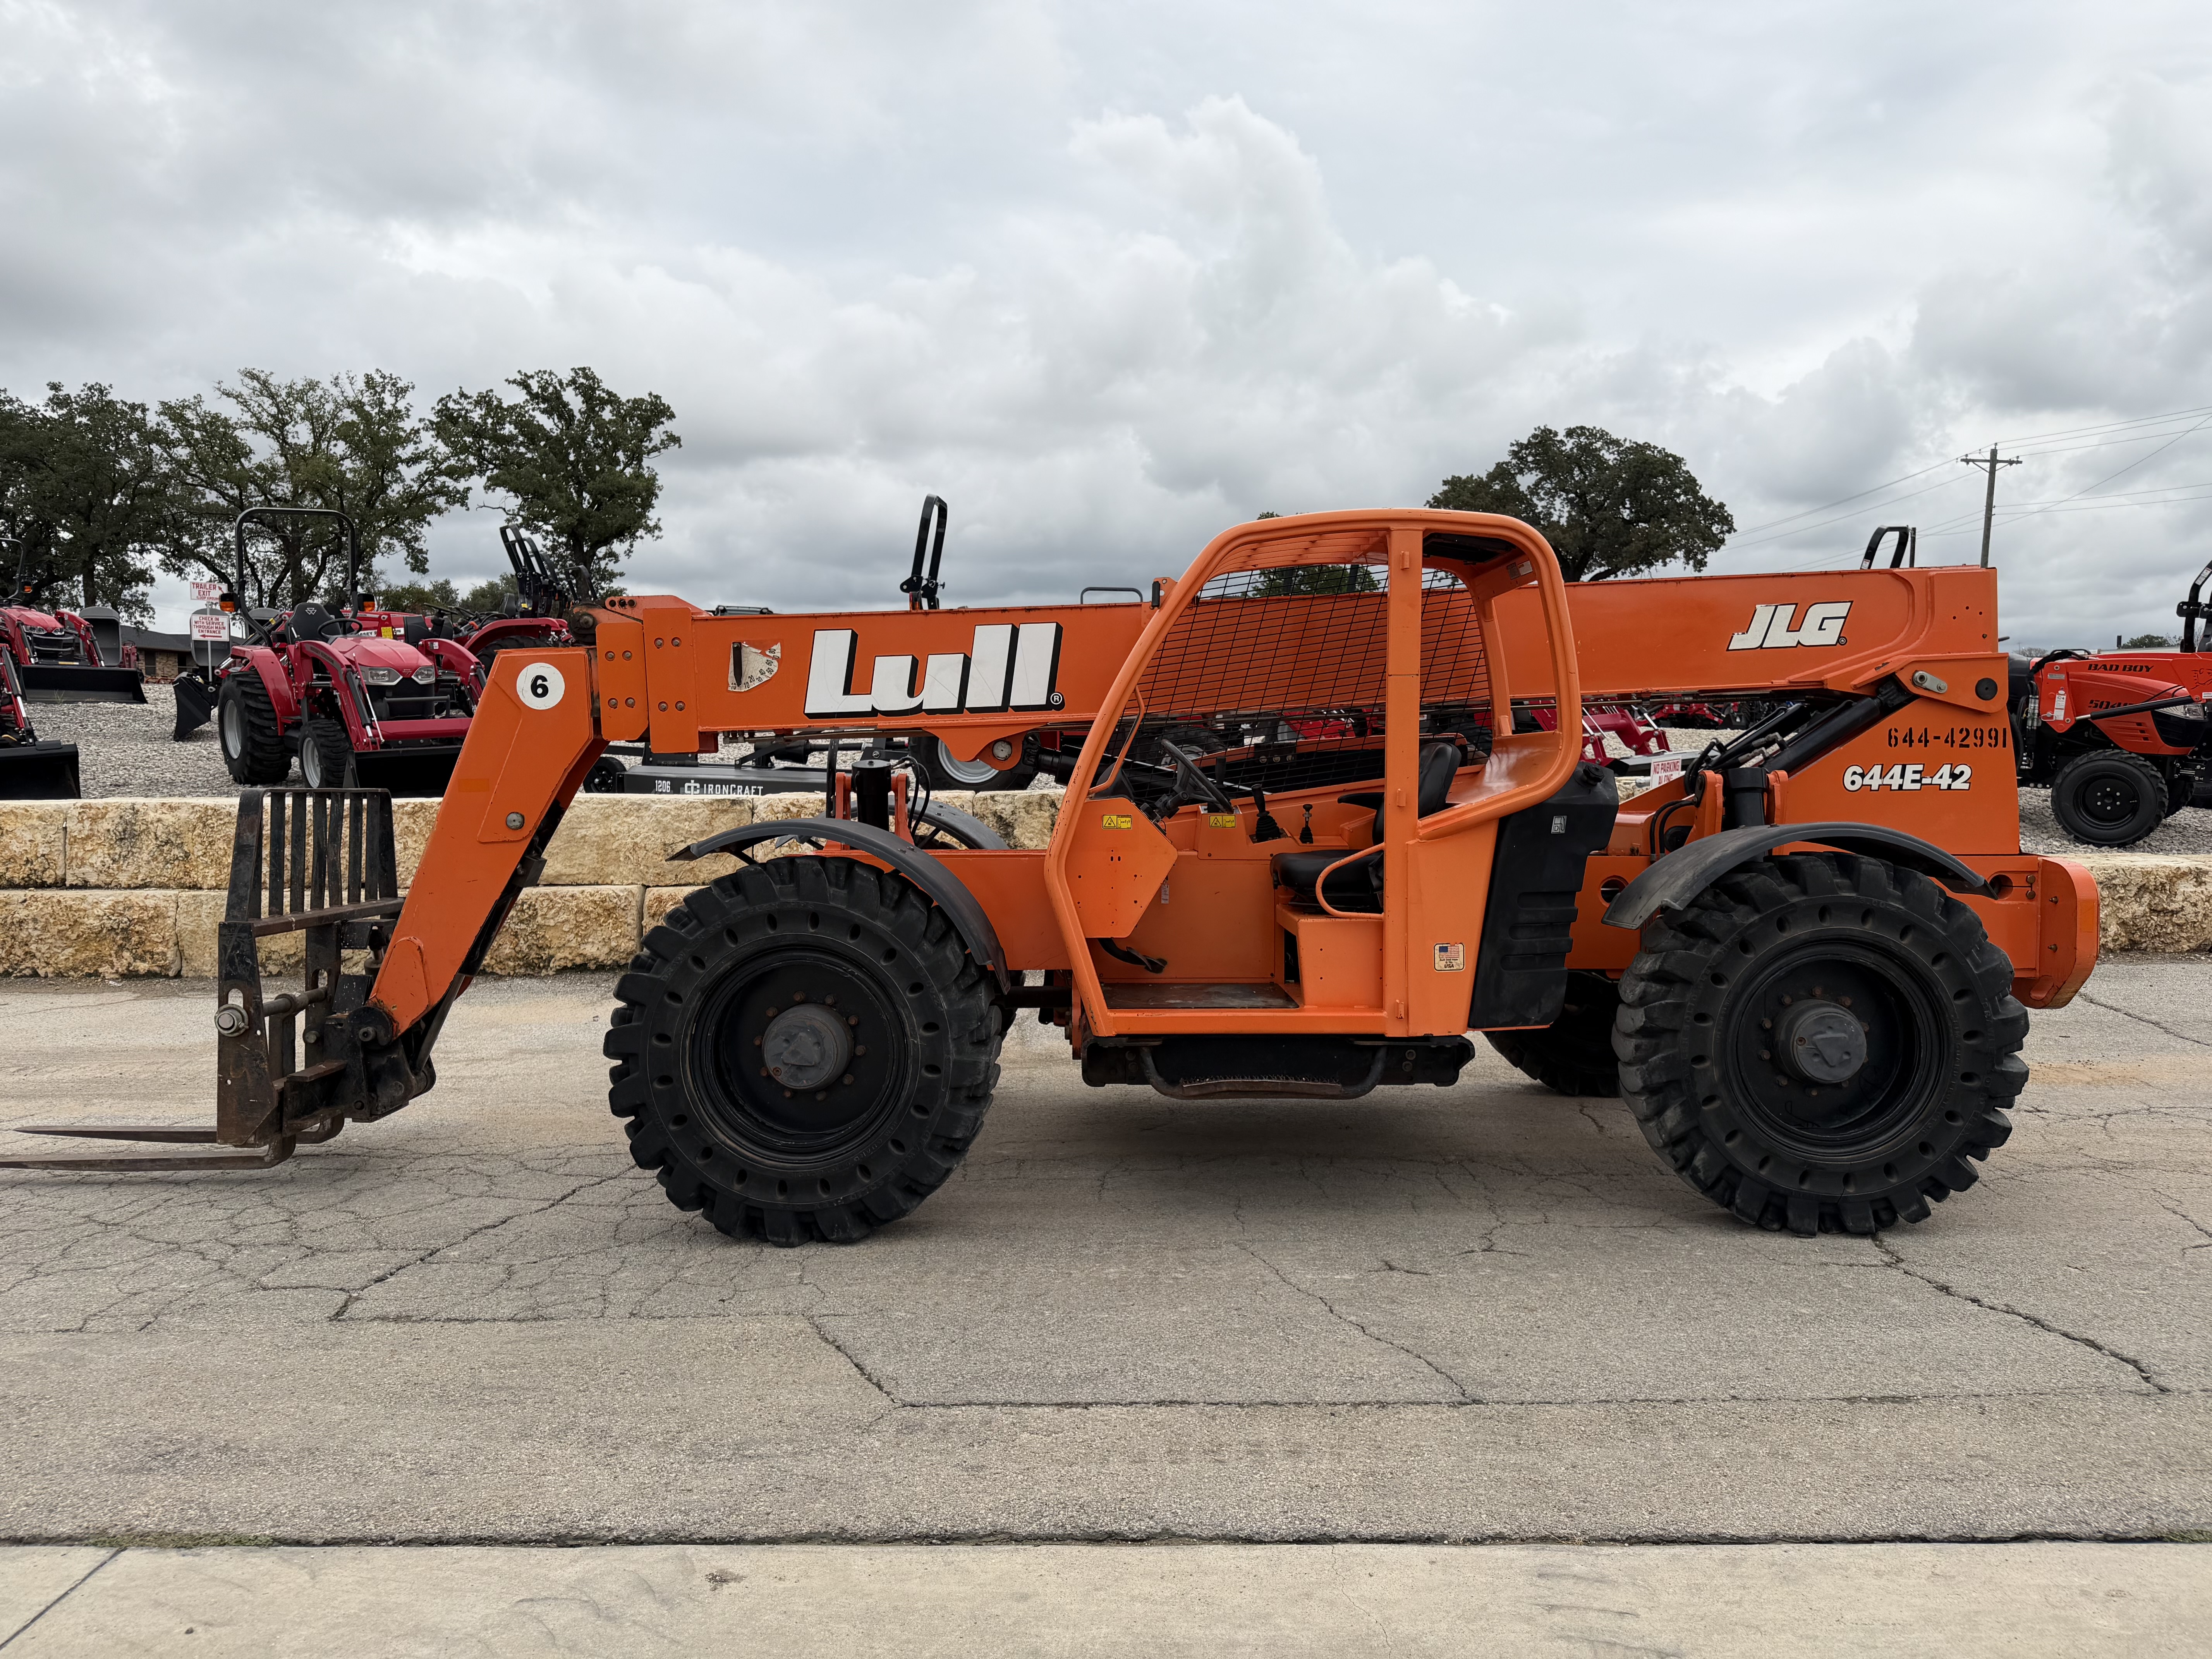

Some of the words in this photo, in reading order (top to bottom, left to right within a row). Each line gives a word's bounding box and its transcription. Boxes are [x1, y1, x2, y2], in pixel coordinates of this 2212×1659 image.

[1726, 601, 1853, 651] JLG
[804, 622, 1063, 719] Lull
[531, 675, 549, 698] 6
[1888, 727, 2007, 748] 644-42991
[1653, 764, 1660, 775] NO
[1661, 761, 1680, 774] PARKING
[1843, 763, 1973, 792] 644E-42
[656, 780, 670, 792] 1206
[704, 784, 763, 796] IRONCRAFT
[708, 911, 743, 934] SOLID
